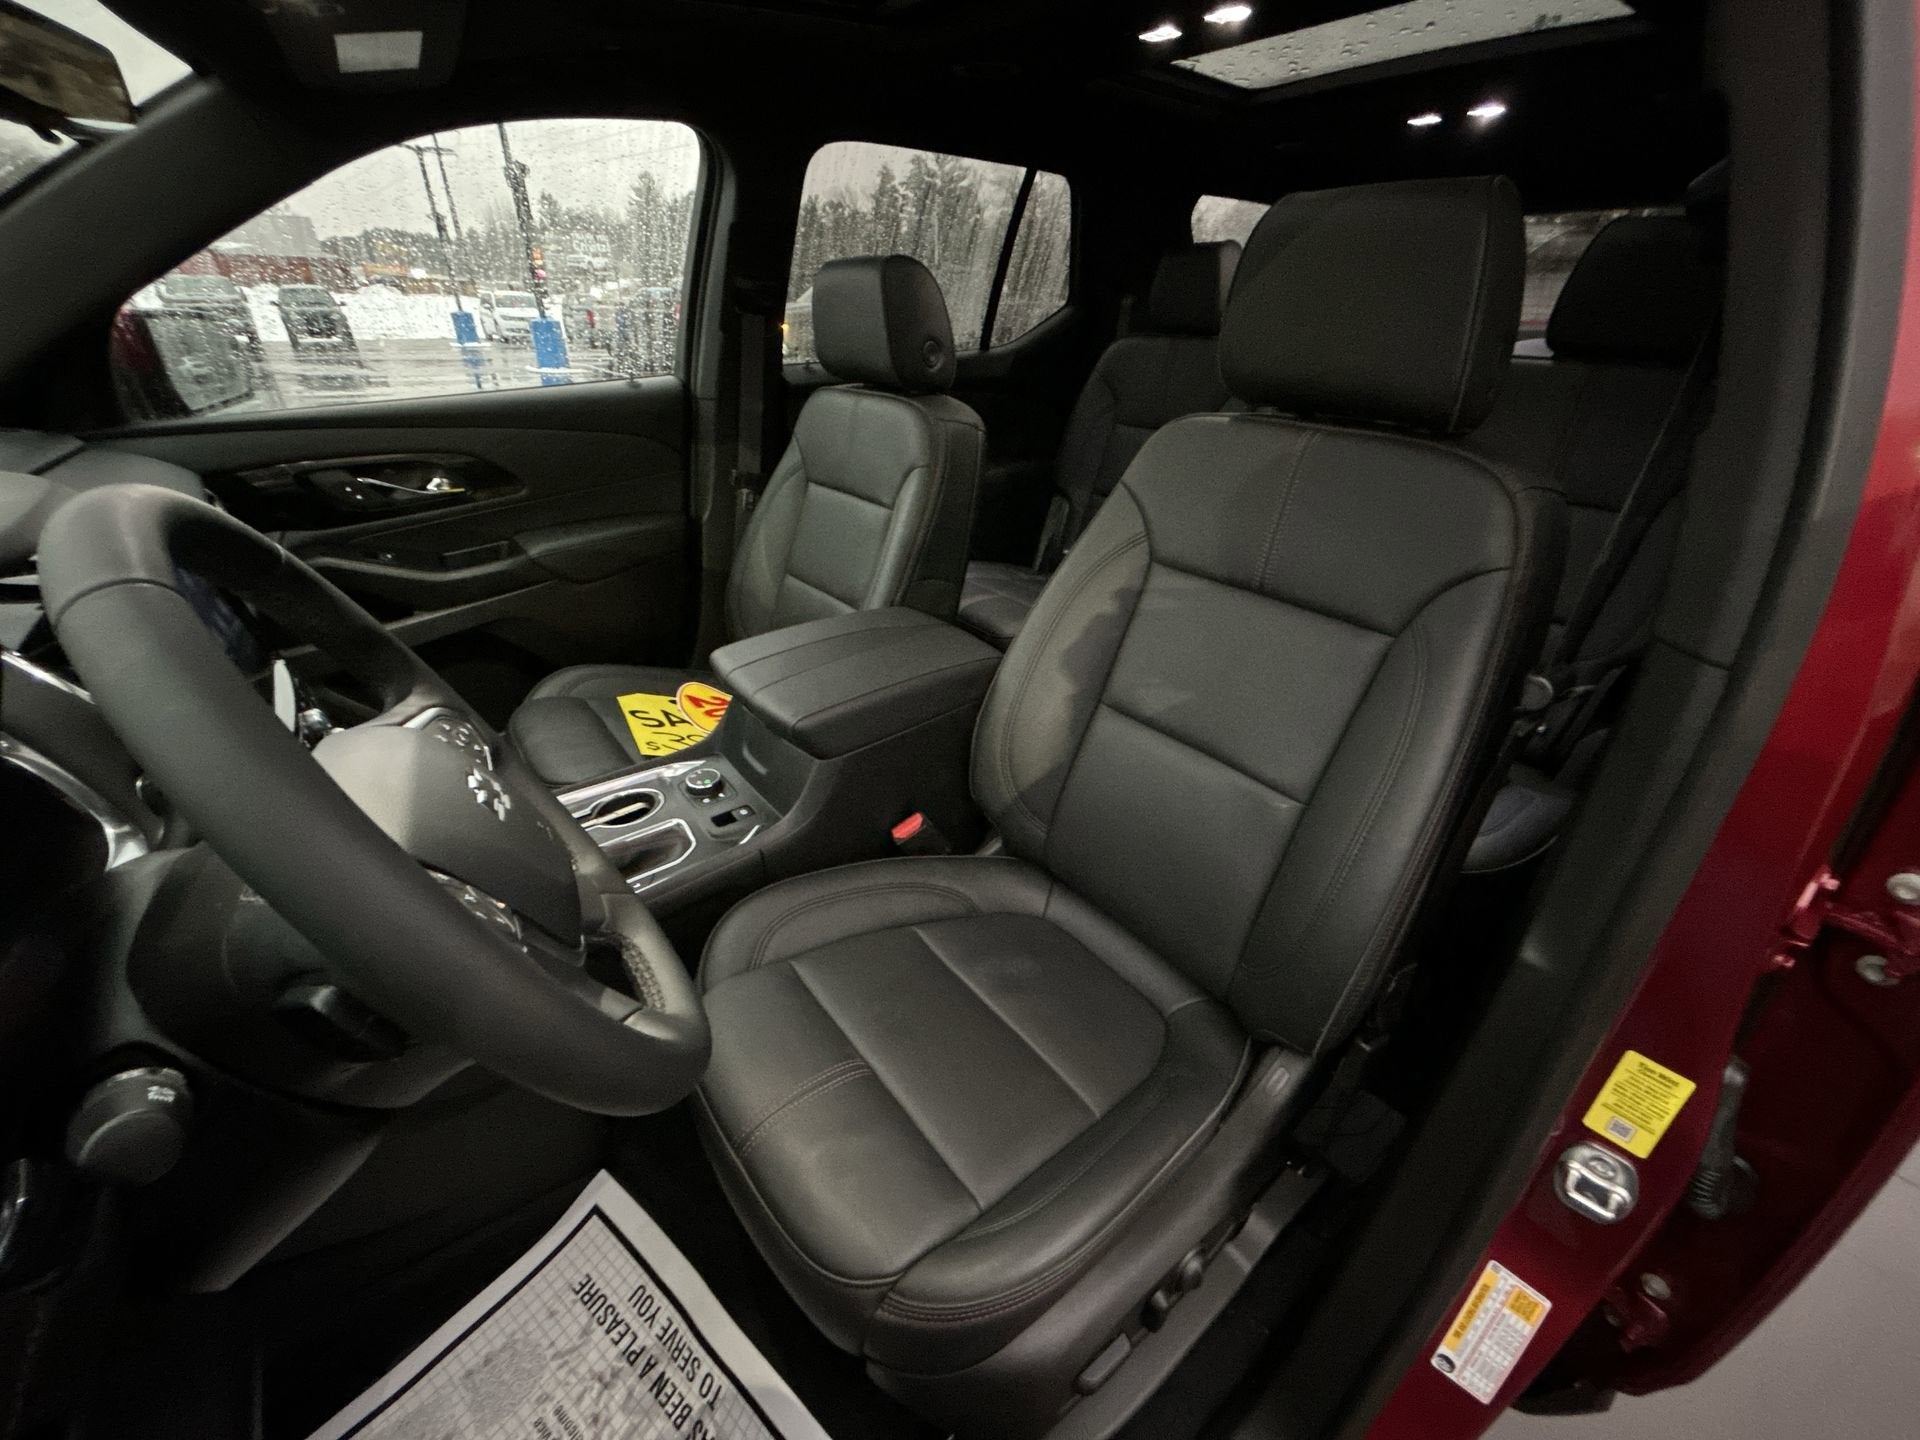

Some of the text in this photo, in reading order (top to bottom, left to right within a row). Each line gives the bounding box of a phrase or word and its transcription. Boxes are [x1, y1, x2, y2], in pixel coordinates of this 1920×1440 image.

[628, 709, 694, 728] SA
[571, 1273, 647, 1367] PLEASURE
[628, 1284, 722, 1412] TO SERVE YOU
[638, 1355, 659, 1379] A
[648, 1371, 692, 1431] BEEN
